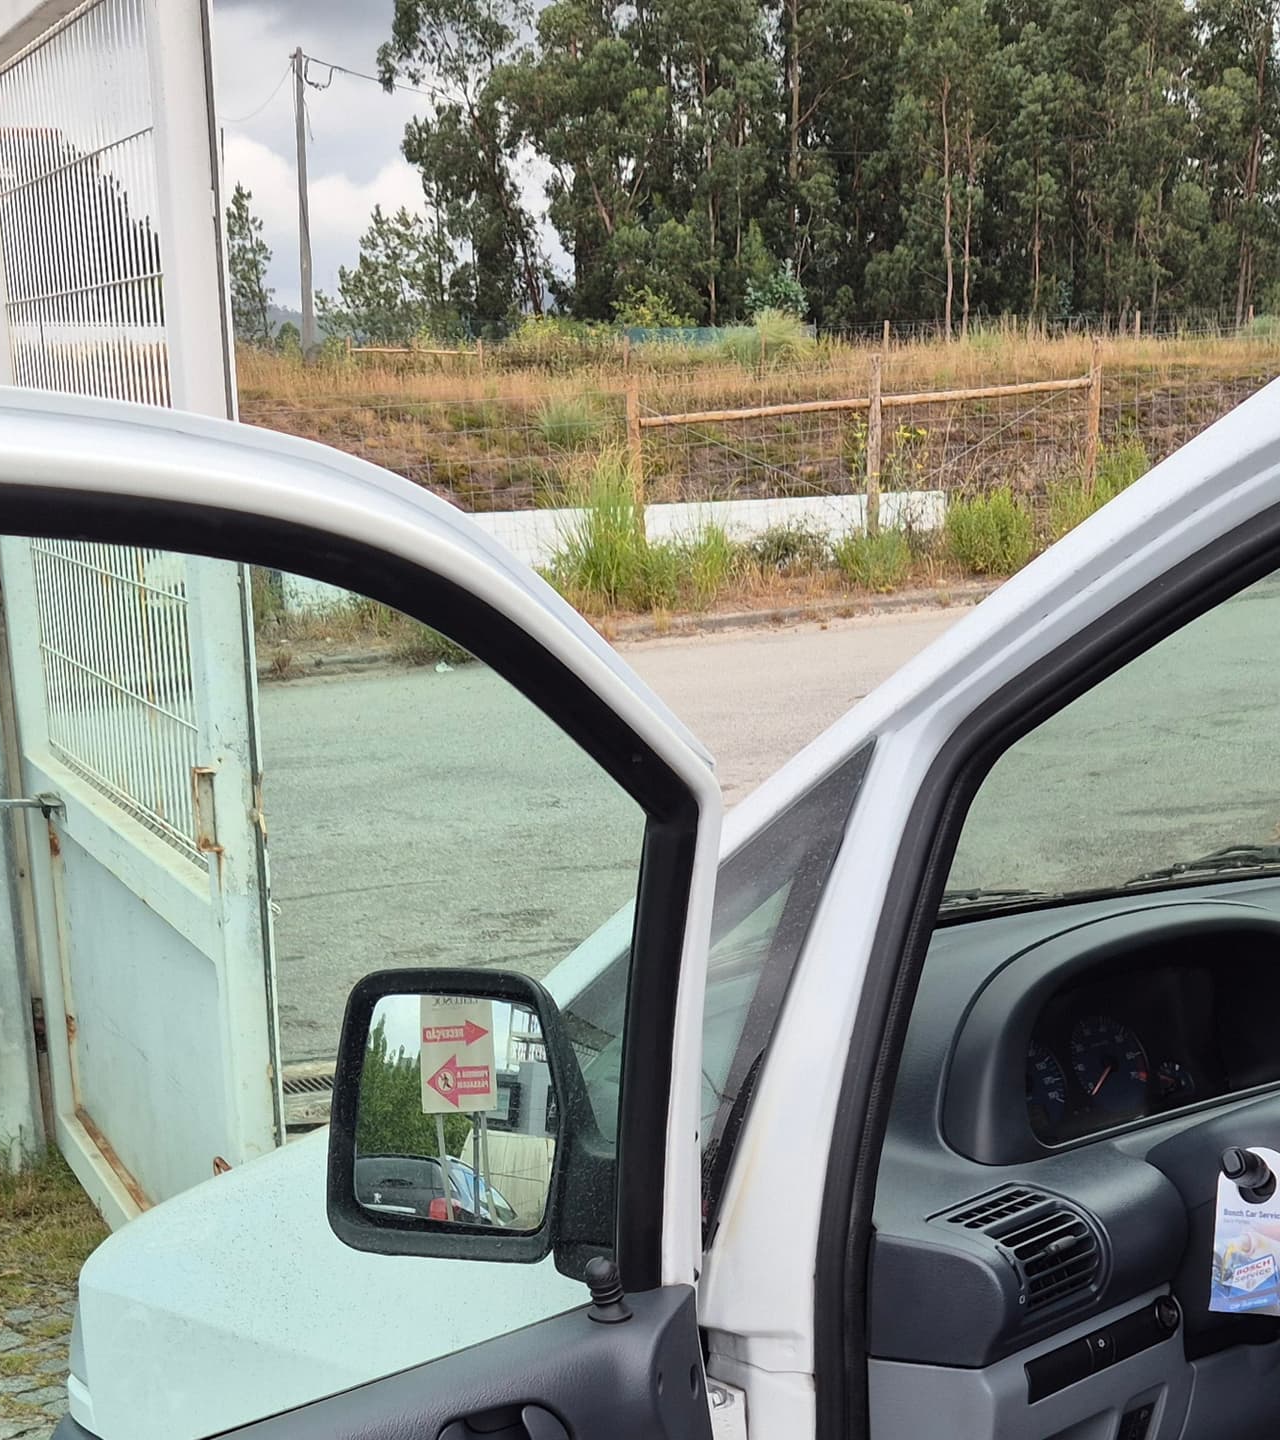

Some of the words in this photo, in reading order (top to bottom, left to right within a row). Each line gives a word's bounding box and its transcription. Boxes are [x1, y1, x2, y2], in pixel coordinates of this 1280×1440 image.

[1223, 1208, 1244, 1217] Bosch
[1245, 1209, 1257, 1218] Car
[1234, 1267, 1272, 1283] Service
[1236, 1259, 1271, 1275] BOSCH
